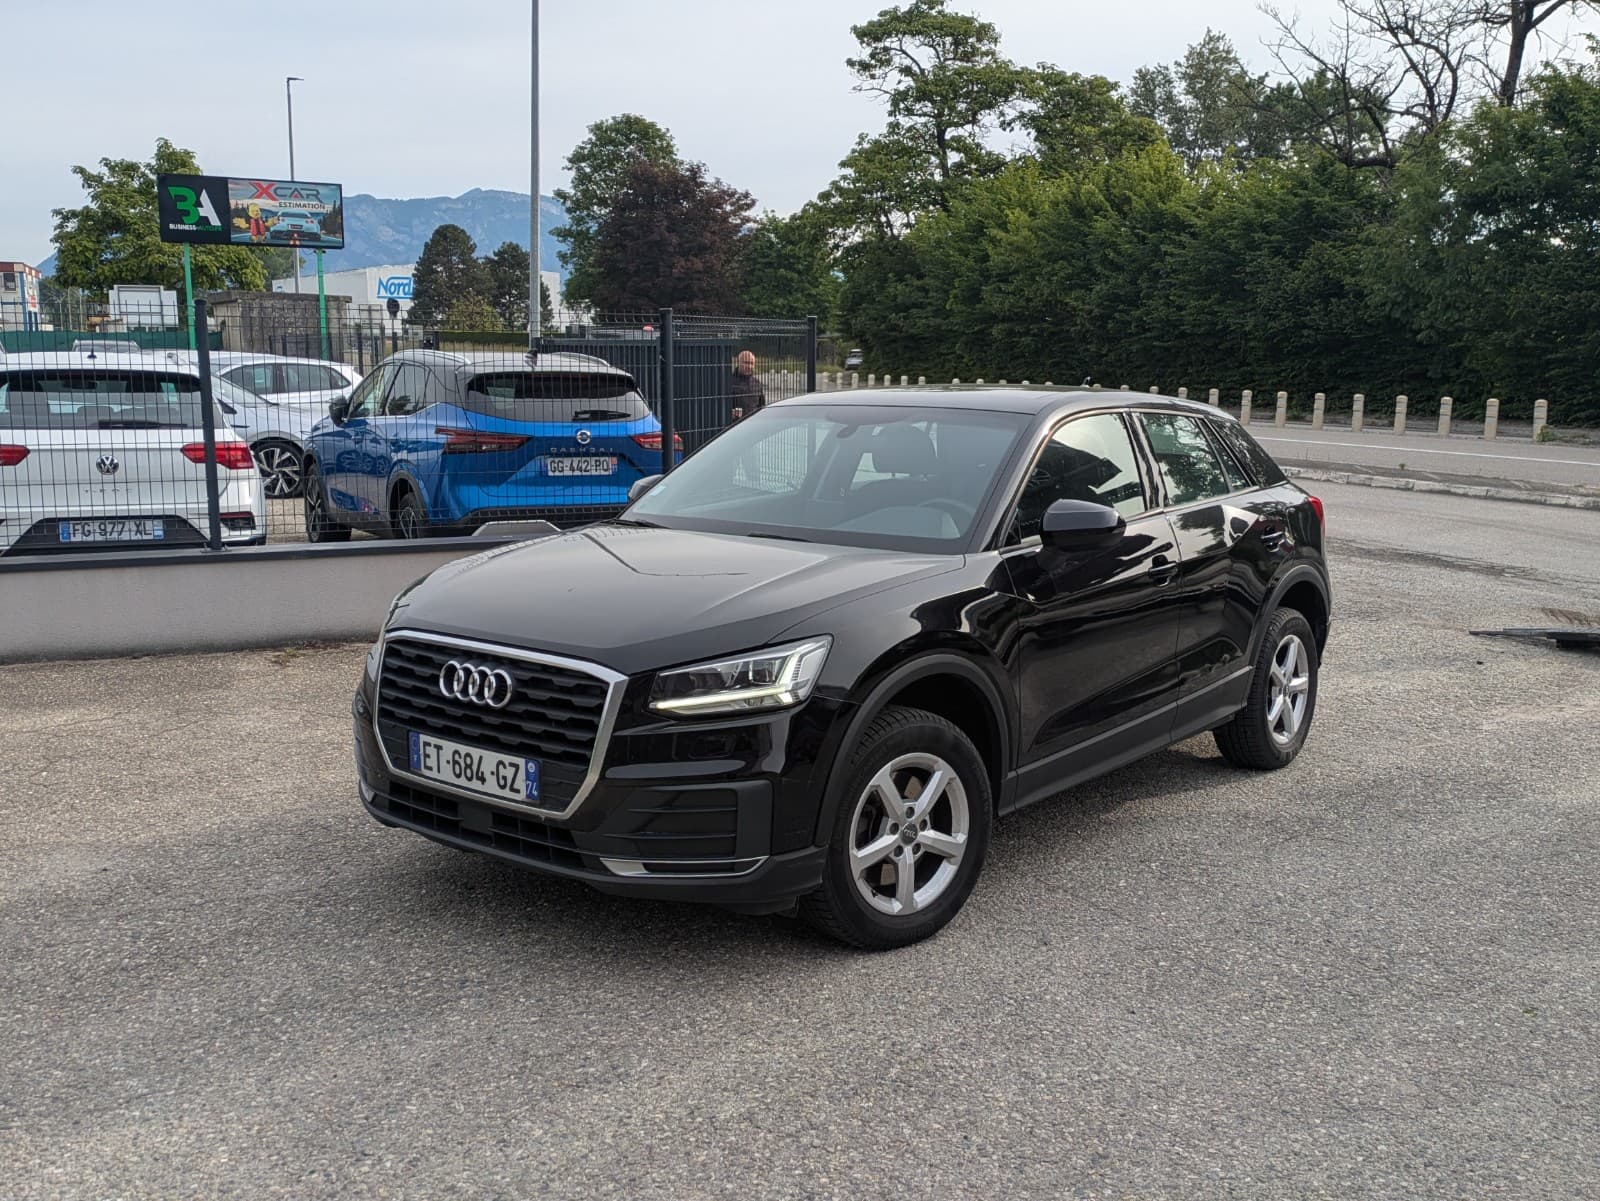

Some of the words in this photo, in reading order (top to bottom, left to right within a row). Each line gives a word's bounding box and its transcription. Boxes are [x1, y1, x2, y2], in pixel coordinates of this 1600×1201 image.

[278, 202, 326, 211] ESTIMATION
[422, 740, 521, 794] ET-684-GZ
[526, 781, 538, 796] 74
